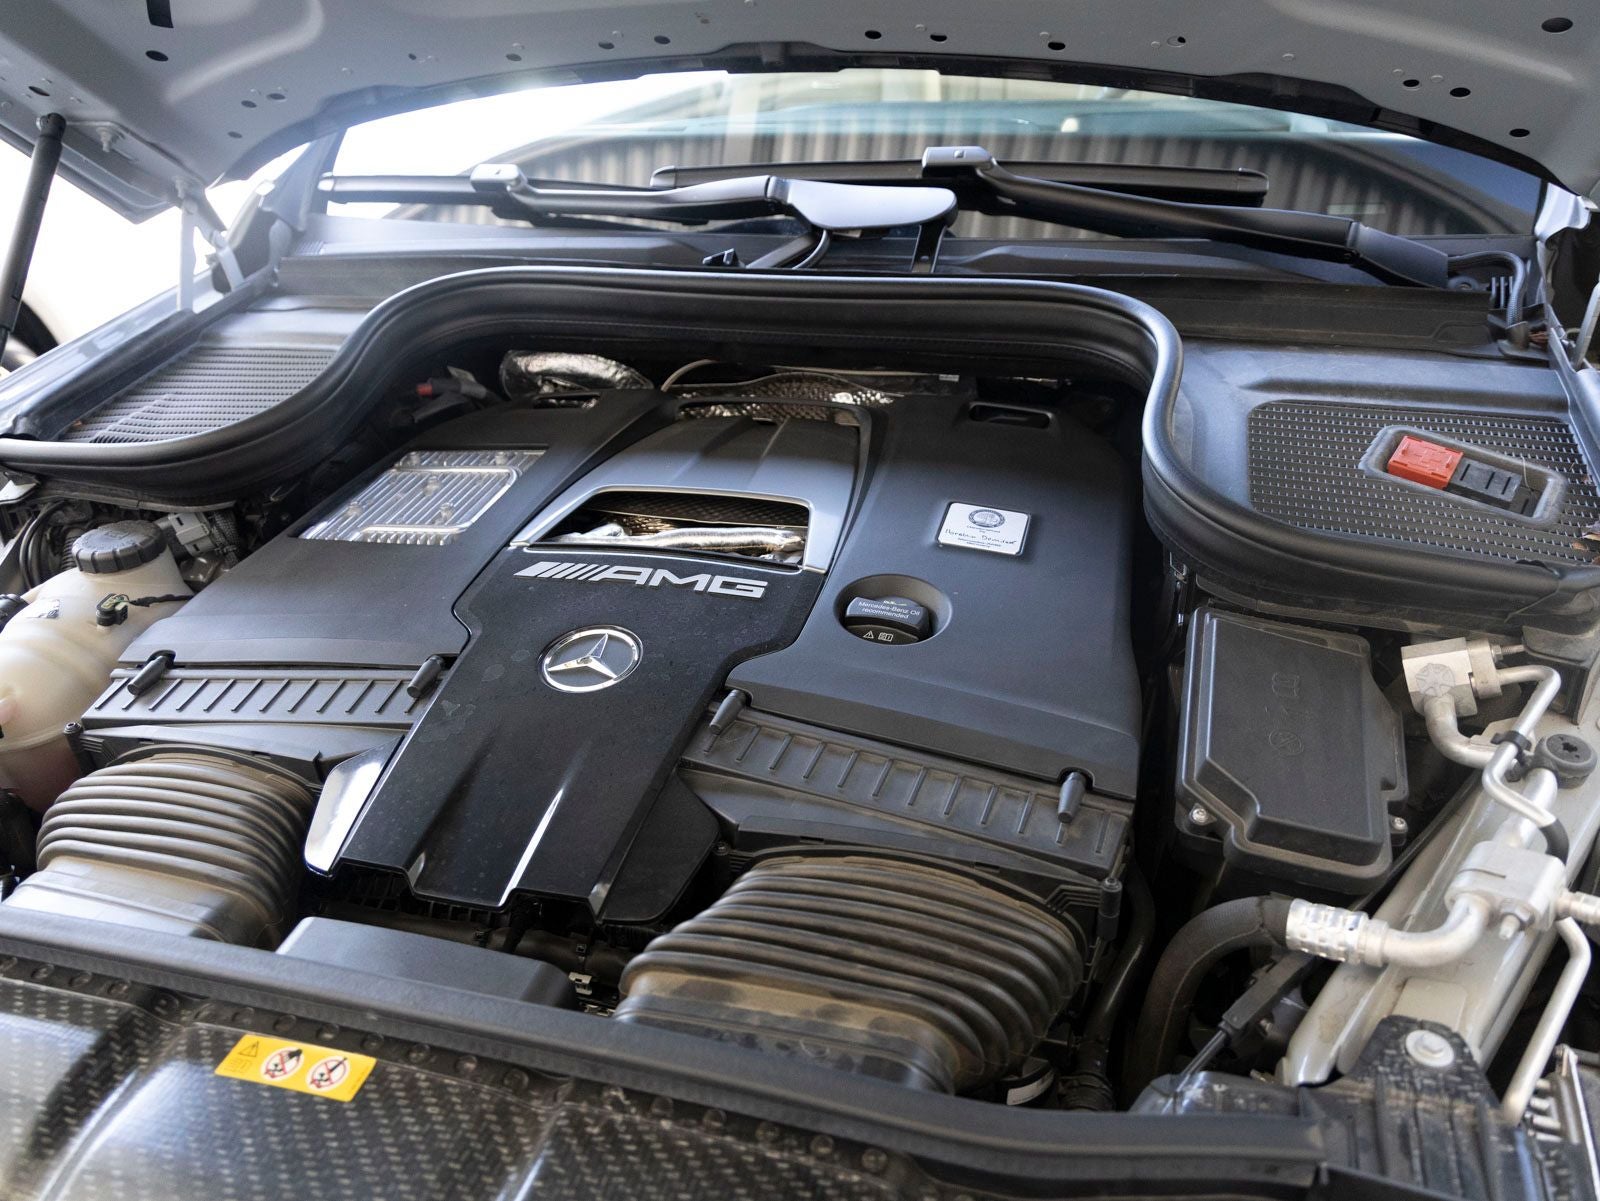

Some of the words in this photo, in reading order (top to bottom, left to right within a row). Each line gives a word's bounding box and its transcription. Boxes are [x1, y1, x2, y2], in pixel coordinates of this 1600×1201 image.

[588, 565, 768, 598] AMG
[858, 601, 909, 614] Mercedes-Benz
[861, 607, 910, 619] recommended
